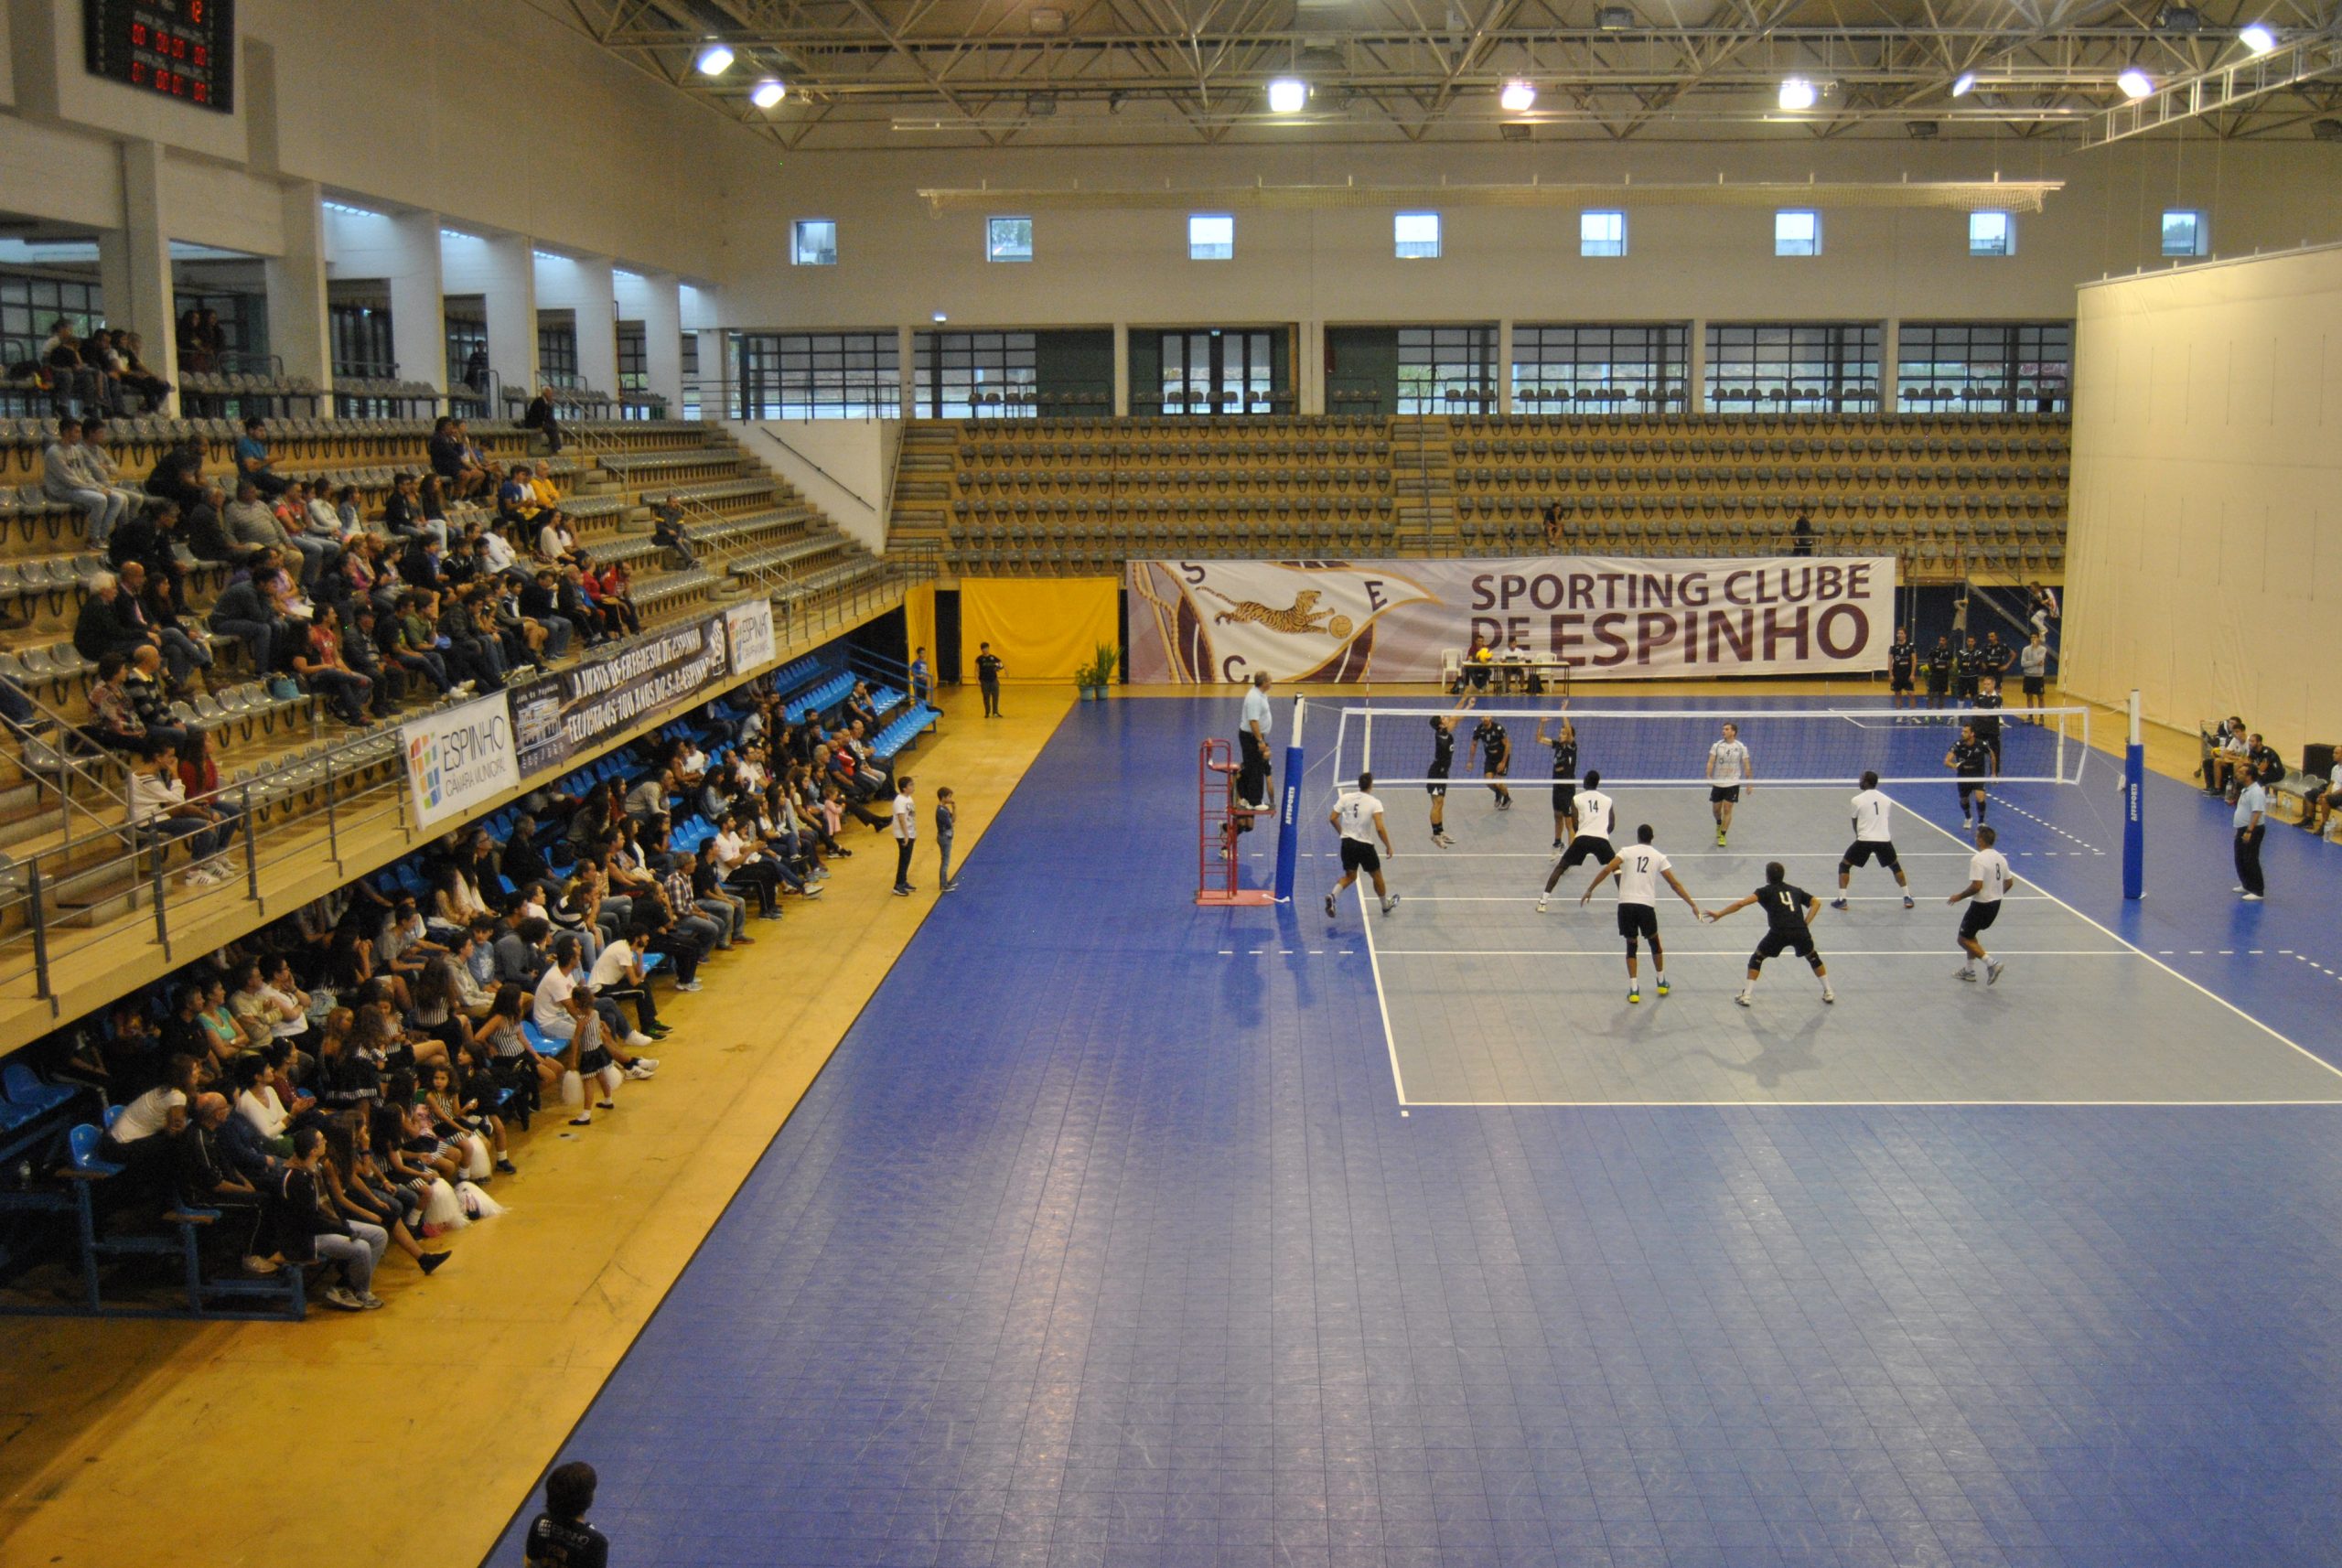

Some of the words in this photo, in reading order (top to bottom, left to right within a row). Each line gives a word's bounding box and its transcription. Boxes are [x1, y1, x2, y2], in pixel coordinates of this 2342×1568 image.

[1364, 580, 1388, 612] E
[1471, 572, 1710, 611] SPORTING
[1724, 564, 1871, 605] CLUBE
[1550, 603, 1871, 667] ESPINHO
[441, 714, 505, 773] ESPINHO
[1588, 800, 1599, 813] 14
[1873, 800, 1879, 816] 1
[1637, 856, 1649, 874] 12
[1995, 863, 2001, 880] 8
[1778, 891, 1795, 912] 4
